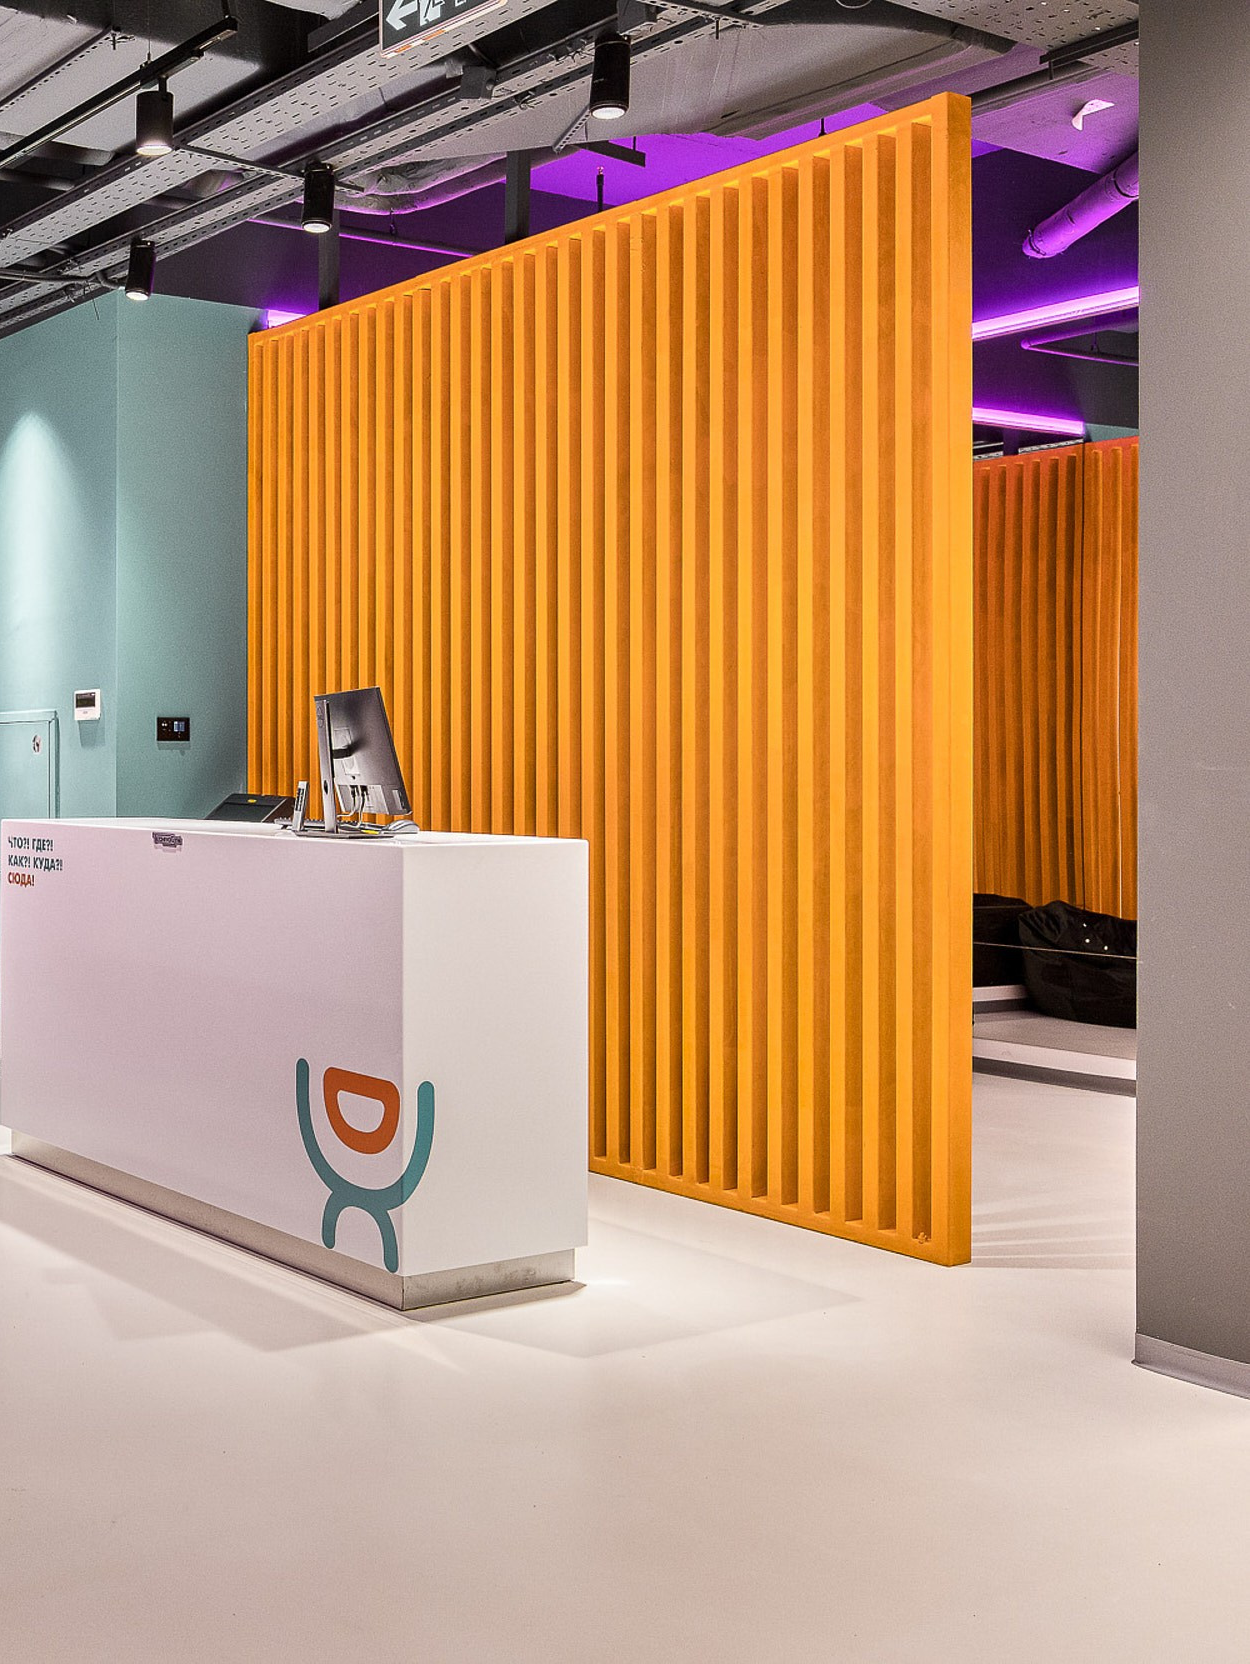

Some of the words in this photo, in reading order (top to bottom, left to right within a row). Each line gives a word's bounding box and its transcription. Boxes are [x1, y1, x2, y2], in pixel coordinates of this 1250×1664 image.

[8, 836, 30, 850] ЧТО?!
[32, 838, 54, 852] ГДЕ?!
[8, 854, 31, 868] КАК?!
[33, 856, 63, 872] КУДА?!
[8, 872, 35, 888] СЮДА!
